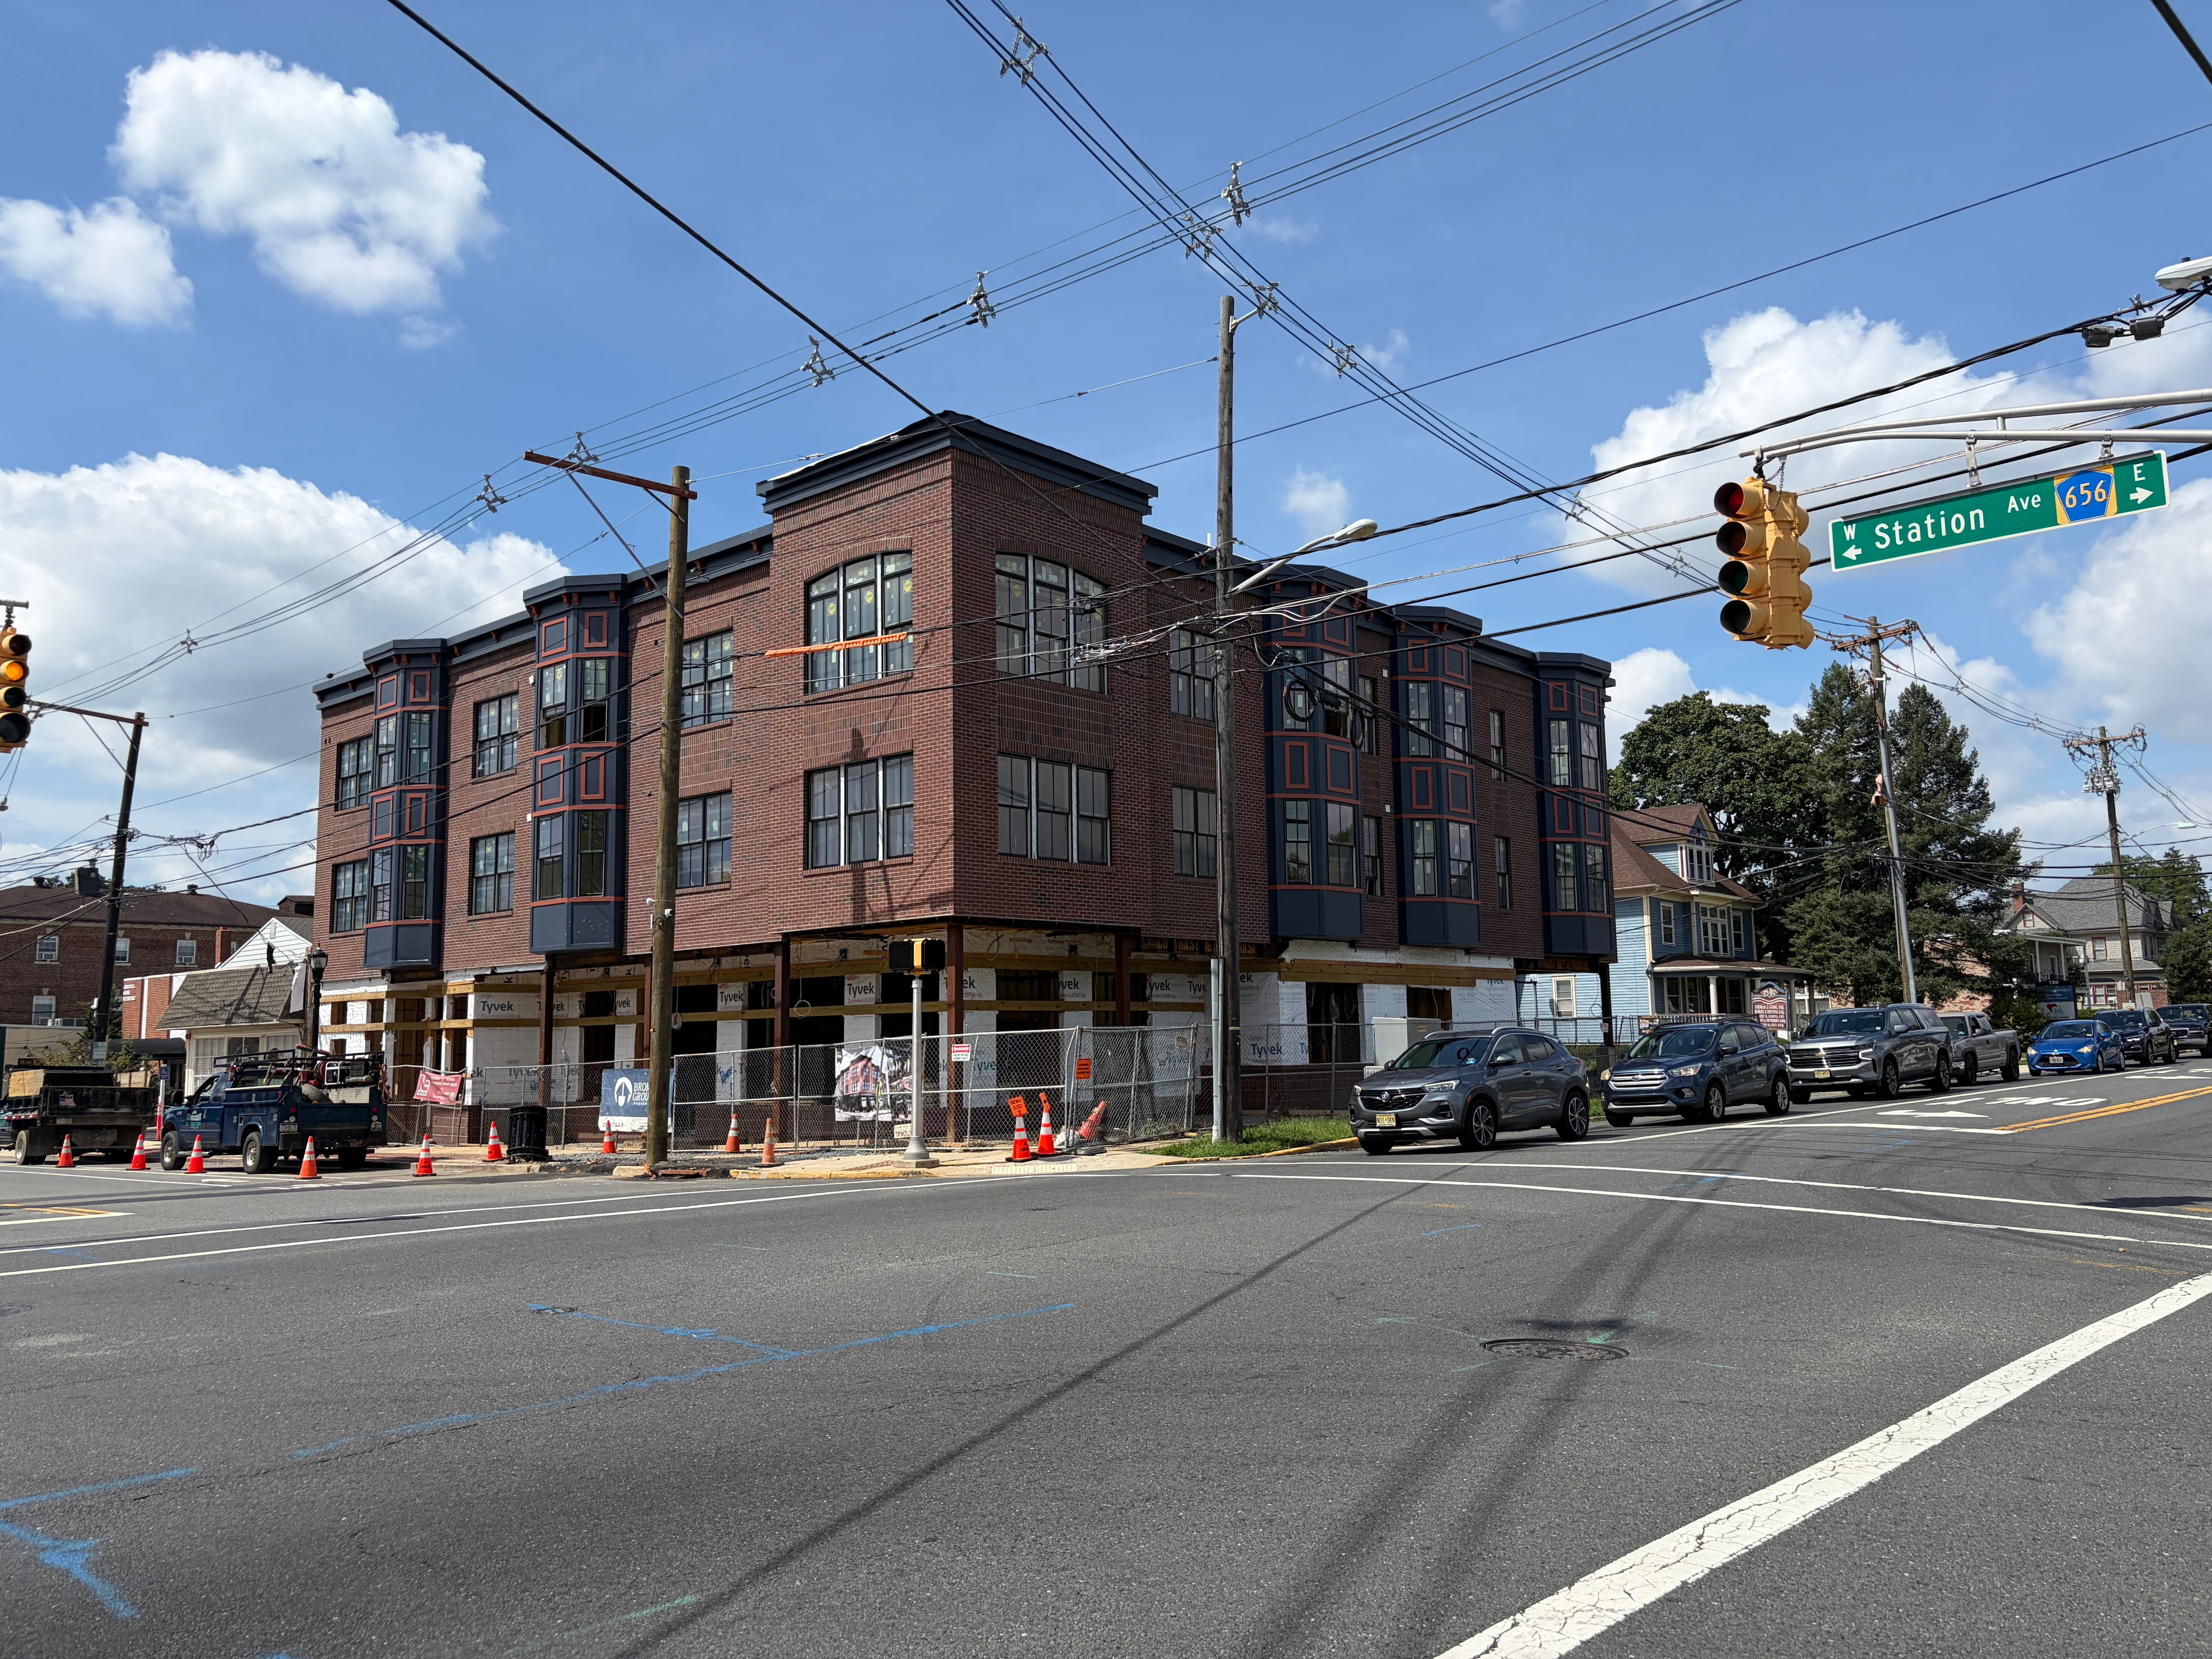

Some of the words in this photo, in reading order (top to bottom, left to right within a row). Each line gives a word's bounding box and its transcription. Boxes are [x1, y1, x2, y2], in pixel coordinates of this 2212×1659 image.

[1844, 524, 1856, 540] W
[1875, 508, 1985, 550] Station
[2008, 494, 2042, 514] Ave
[2065, 479, 2108, 508] 656
[2133, 463, 2146, 482] E
[1157, 938, 1198, 952] COTRAST
[720, 990, 744, 1005] Tyvek
[847, 983, 875, 998] Tyvek
[480, 1000, 514, 1014] Tyvek
[1251, 1042, 1283, 1058] Tyvek
[632, 1092, 649, 1101] GROU
[1925, 1097, 2107, 1106] ONLY
